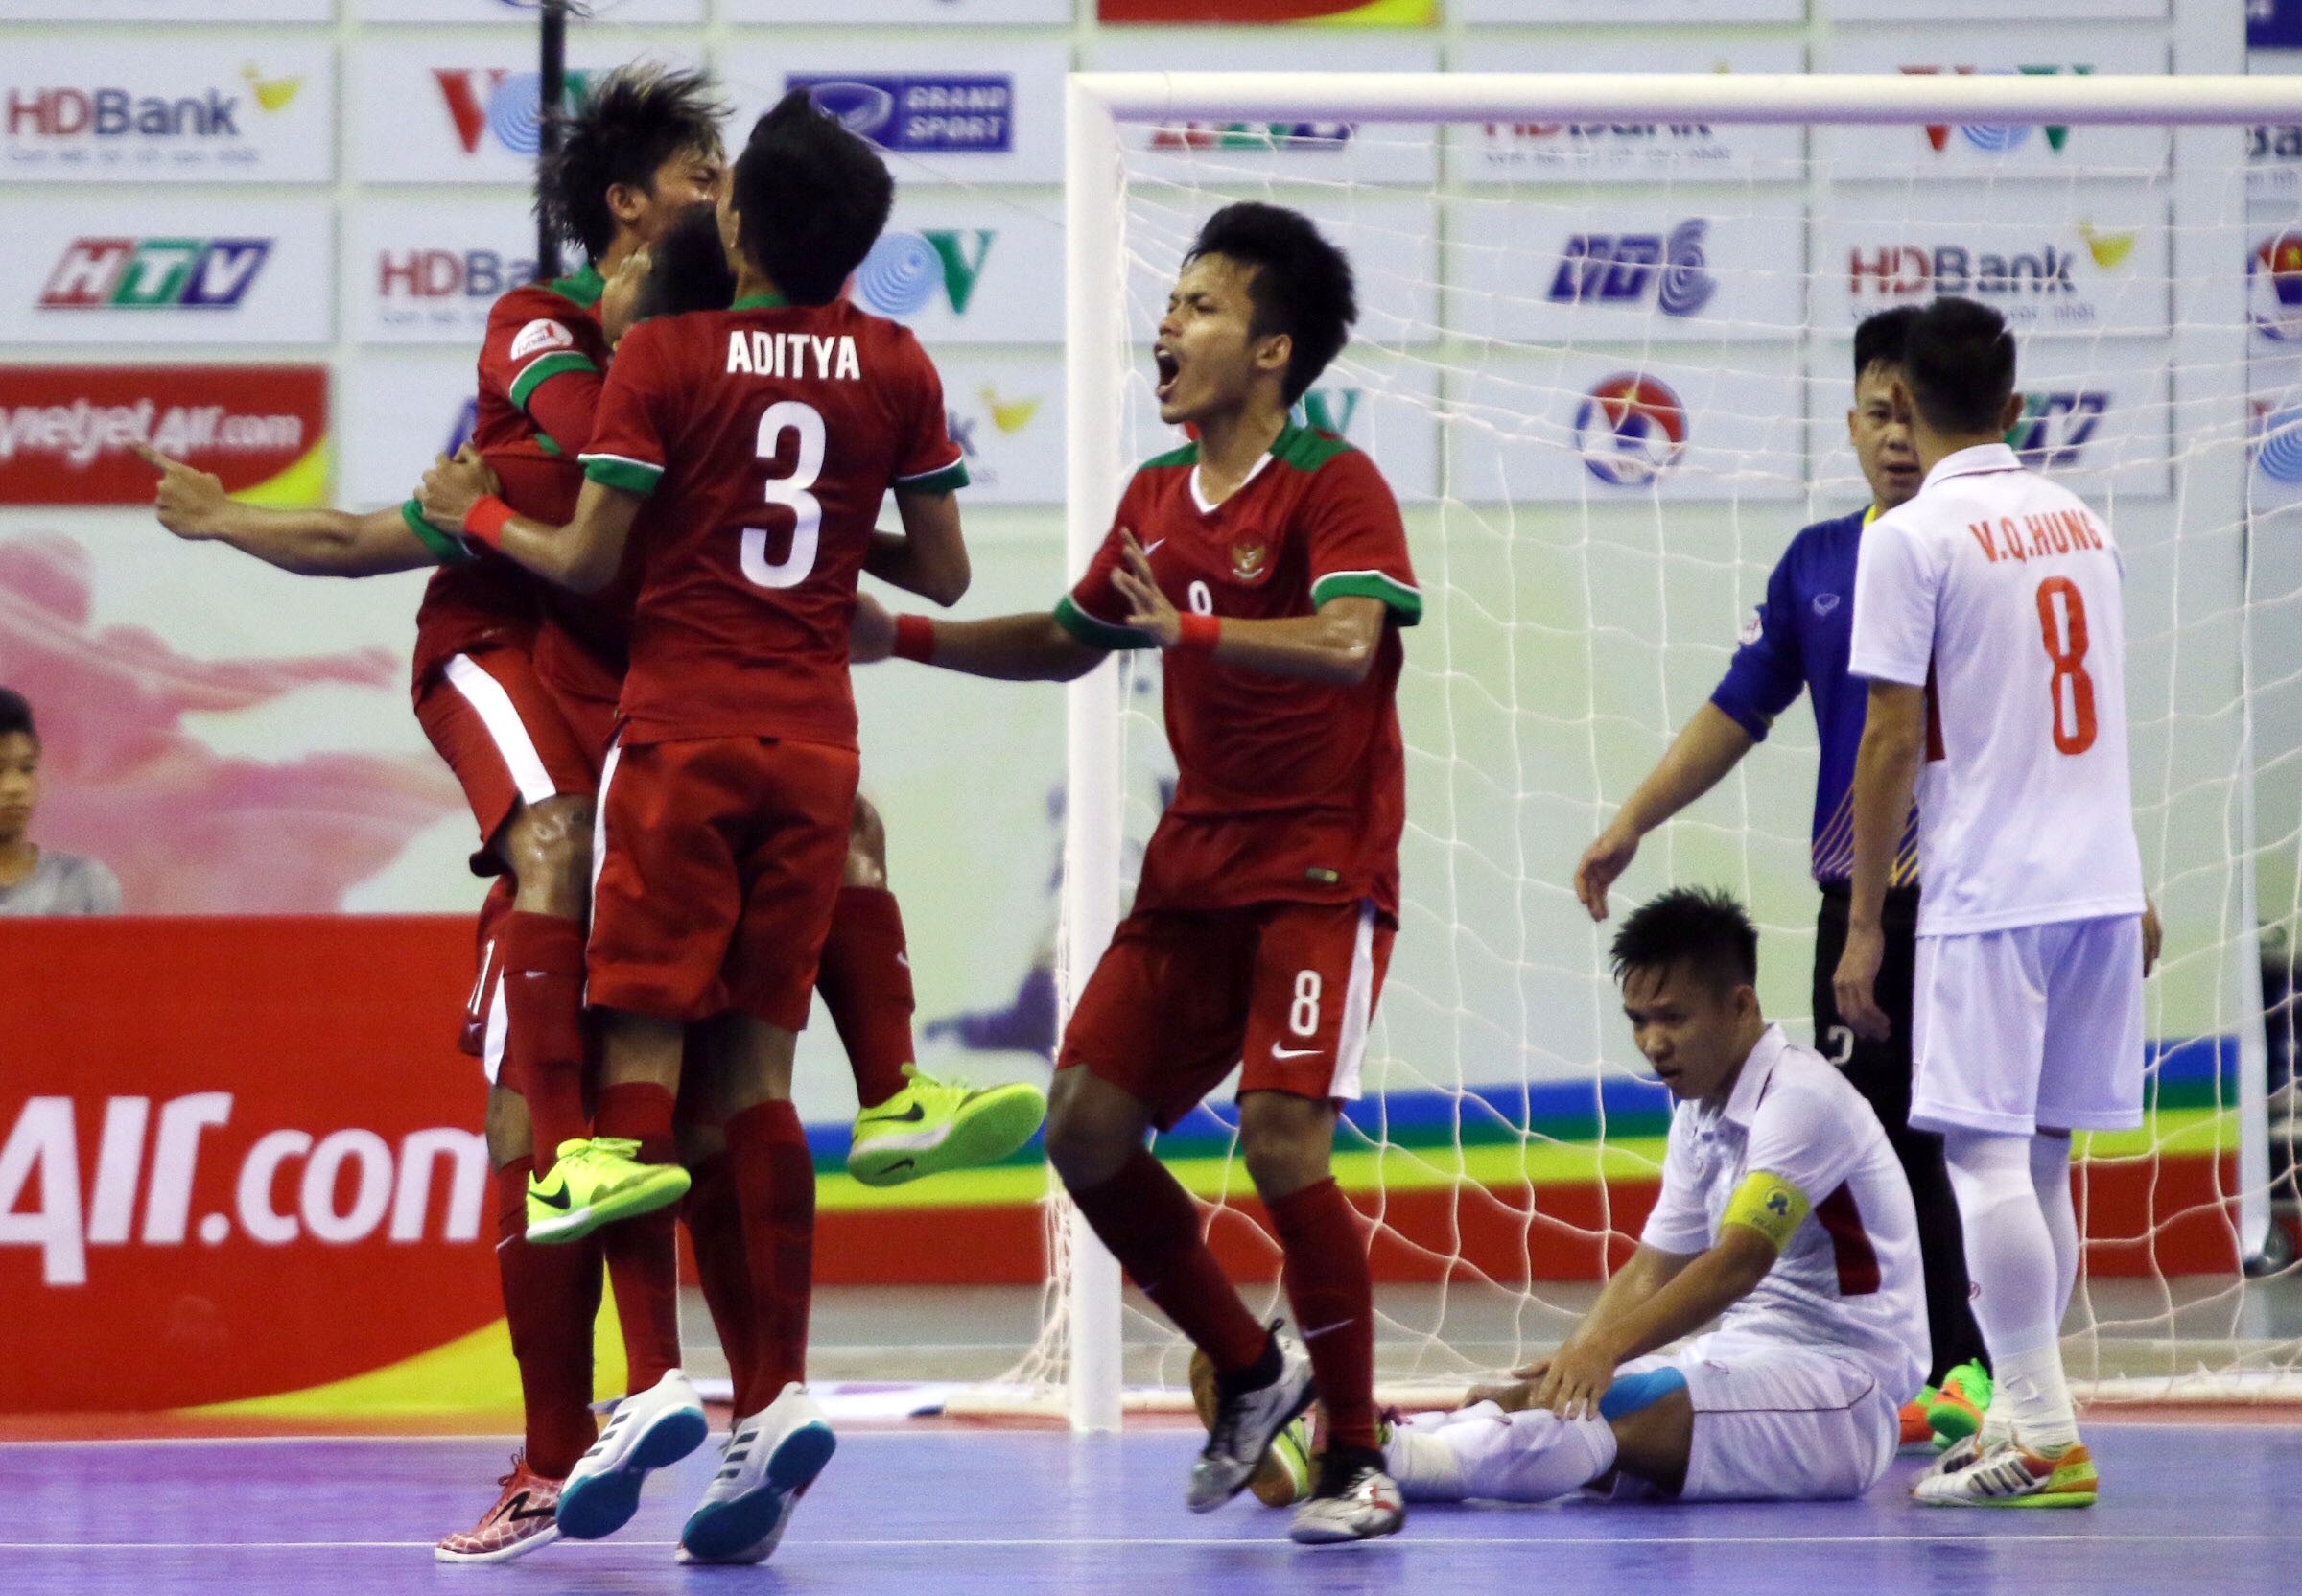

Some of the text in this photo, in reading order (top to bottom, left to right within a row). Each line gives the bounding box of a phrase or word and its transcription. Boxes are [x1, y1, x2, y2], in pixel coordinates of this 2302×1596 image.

[7, 86, 240, 135] HDBank
[907, 86, 1008, 108] GRAND
[906, 115, 1005, 139] SPORT
[36, 237, 274, 309] HTV
[378, 248, 543, 296] HDBa
[1849, 244, 2077, 293] HDBank
[726, 330, 861, 380] ADITYA
[740, 399, 827, 589] 3
[2035, 575, 2098, 755] 8
[1289, 969, 1322, 1037] 8
